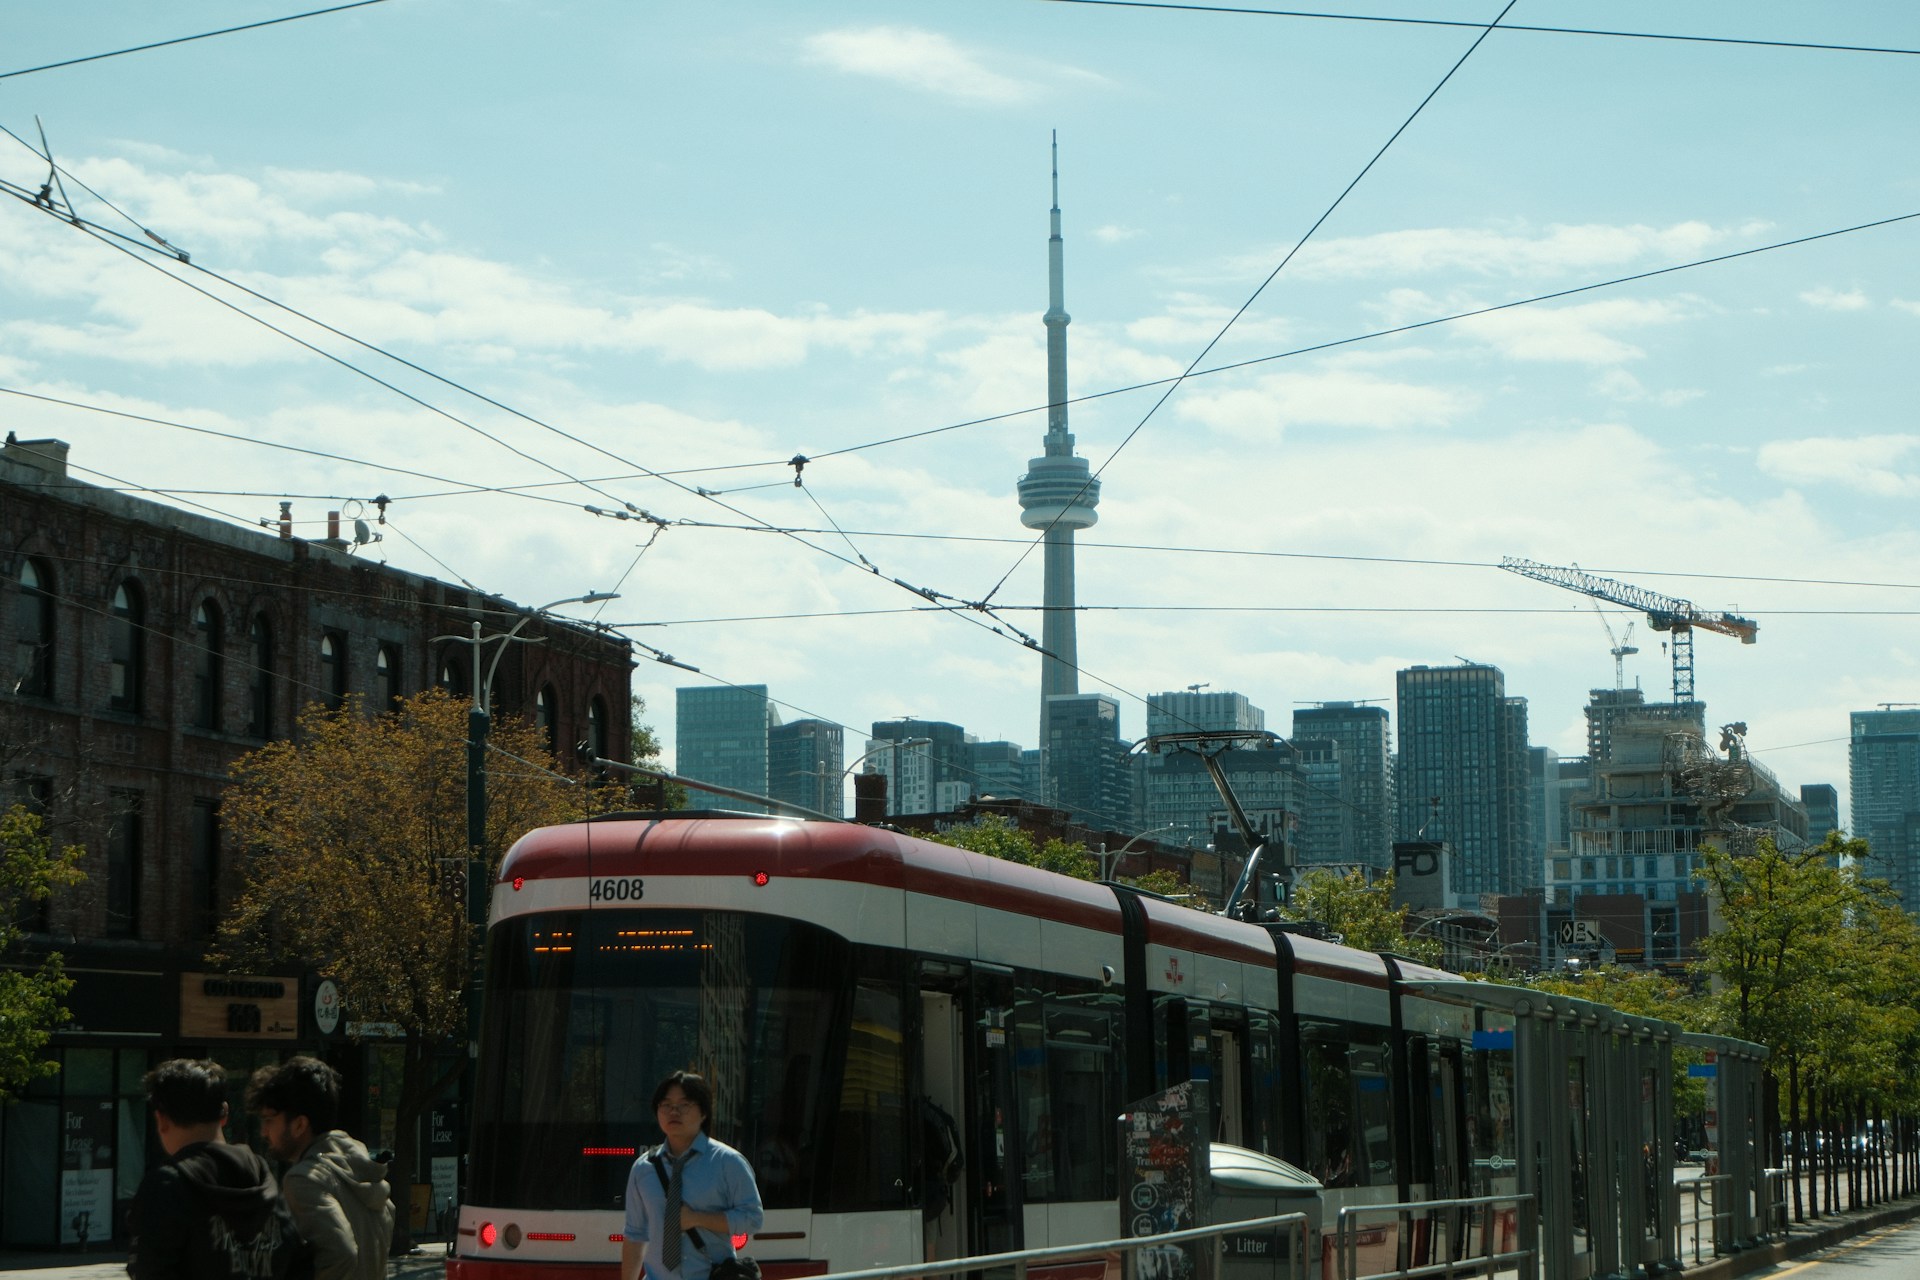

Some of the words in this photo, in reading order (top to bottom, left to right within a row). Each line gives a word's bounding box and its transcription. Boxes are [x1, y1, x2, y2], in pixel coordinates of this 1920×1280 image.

[590, 879, 644, 900] 4608
[65, 1111, 83, 1129] For
[432, 1111, 444, 1127] For
[64, 1134, 94, 1152] Lease
[432, 1130, 452, 1143] Lease
[1236, 1237, 1267, 1253] Litter
